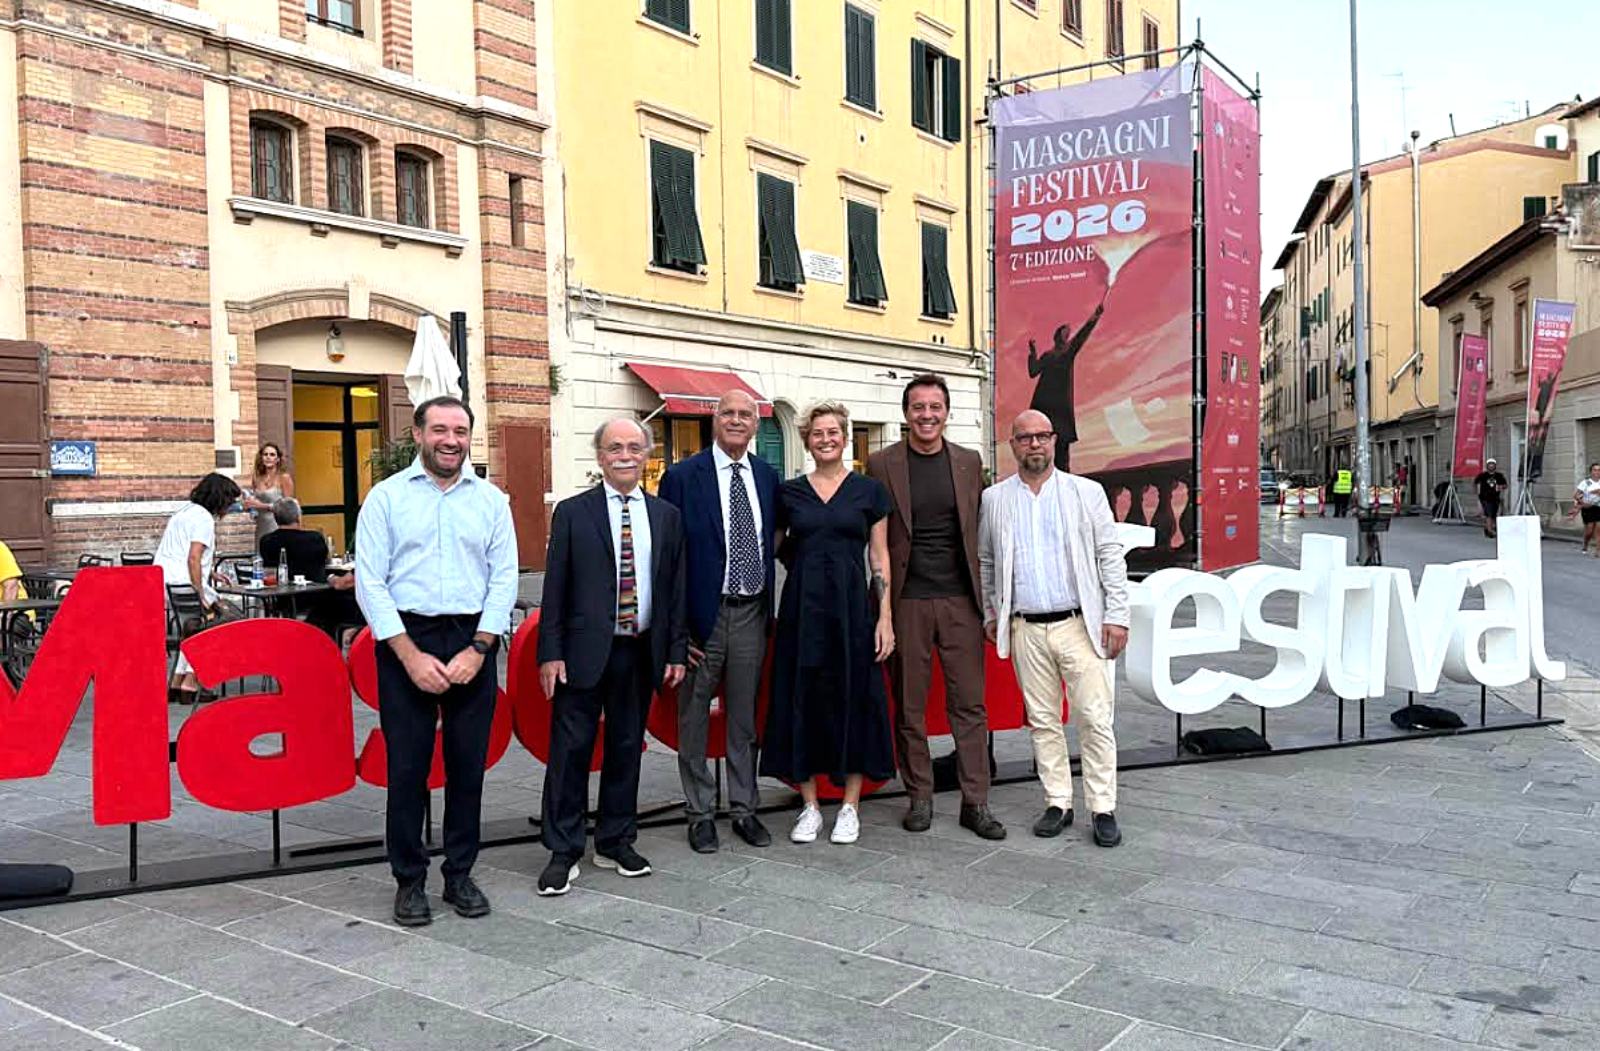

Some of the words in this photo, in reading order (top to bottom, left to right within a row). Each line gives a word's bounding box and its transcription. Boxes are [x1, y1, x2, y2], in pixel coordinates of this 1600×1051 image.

[1011, 115, 1172, 170] MASCAGNI
[1011, 158, 1149, 208] FESTIVAL
[1010, 200, 1147, 246] 2026
[1025, 244, 1096, 268] EDIZIONE
